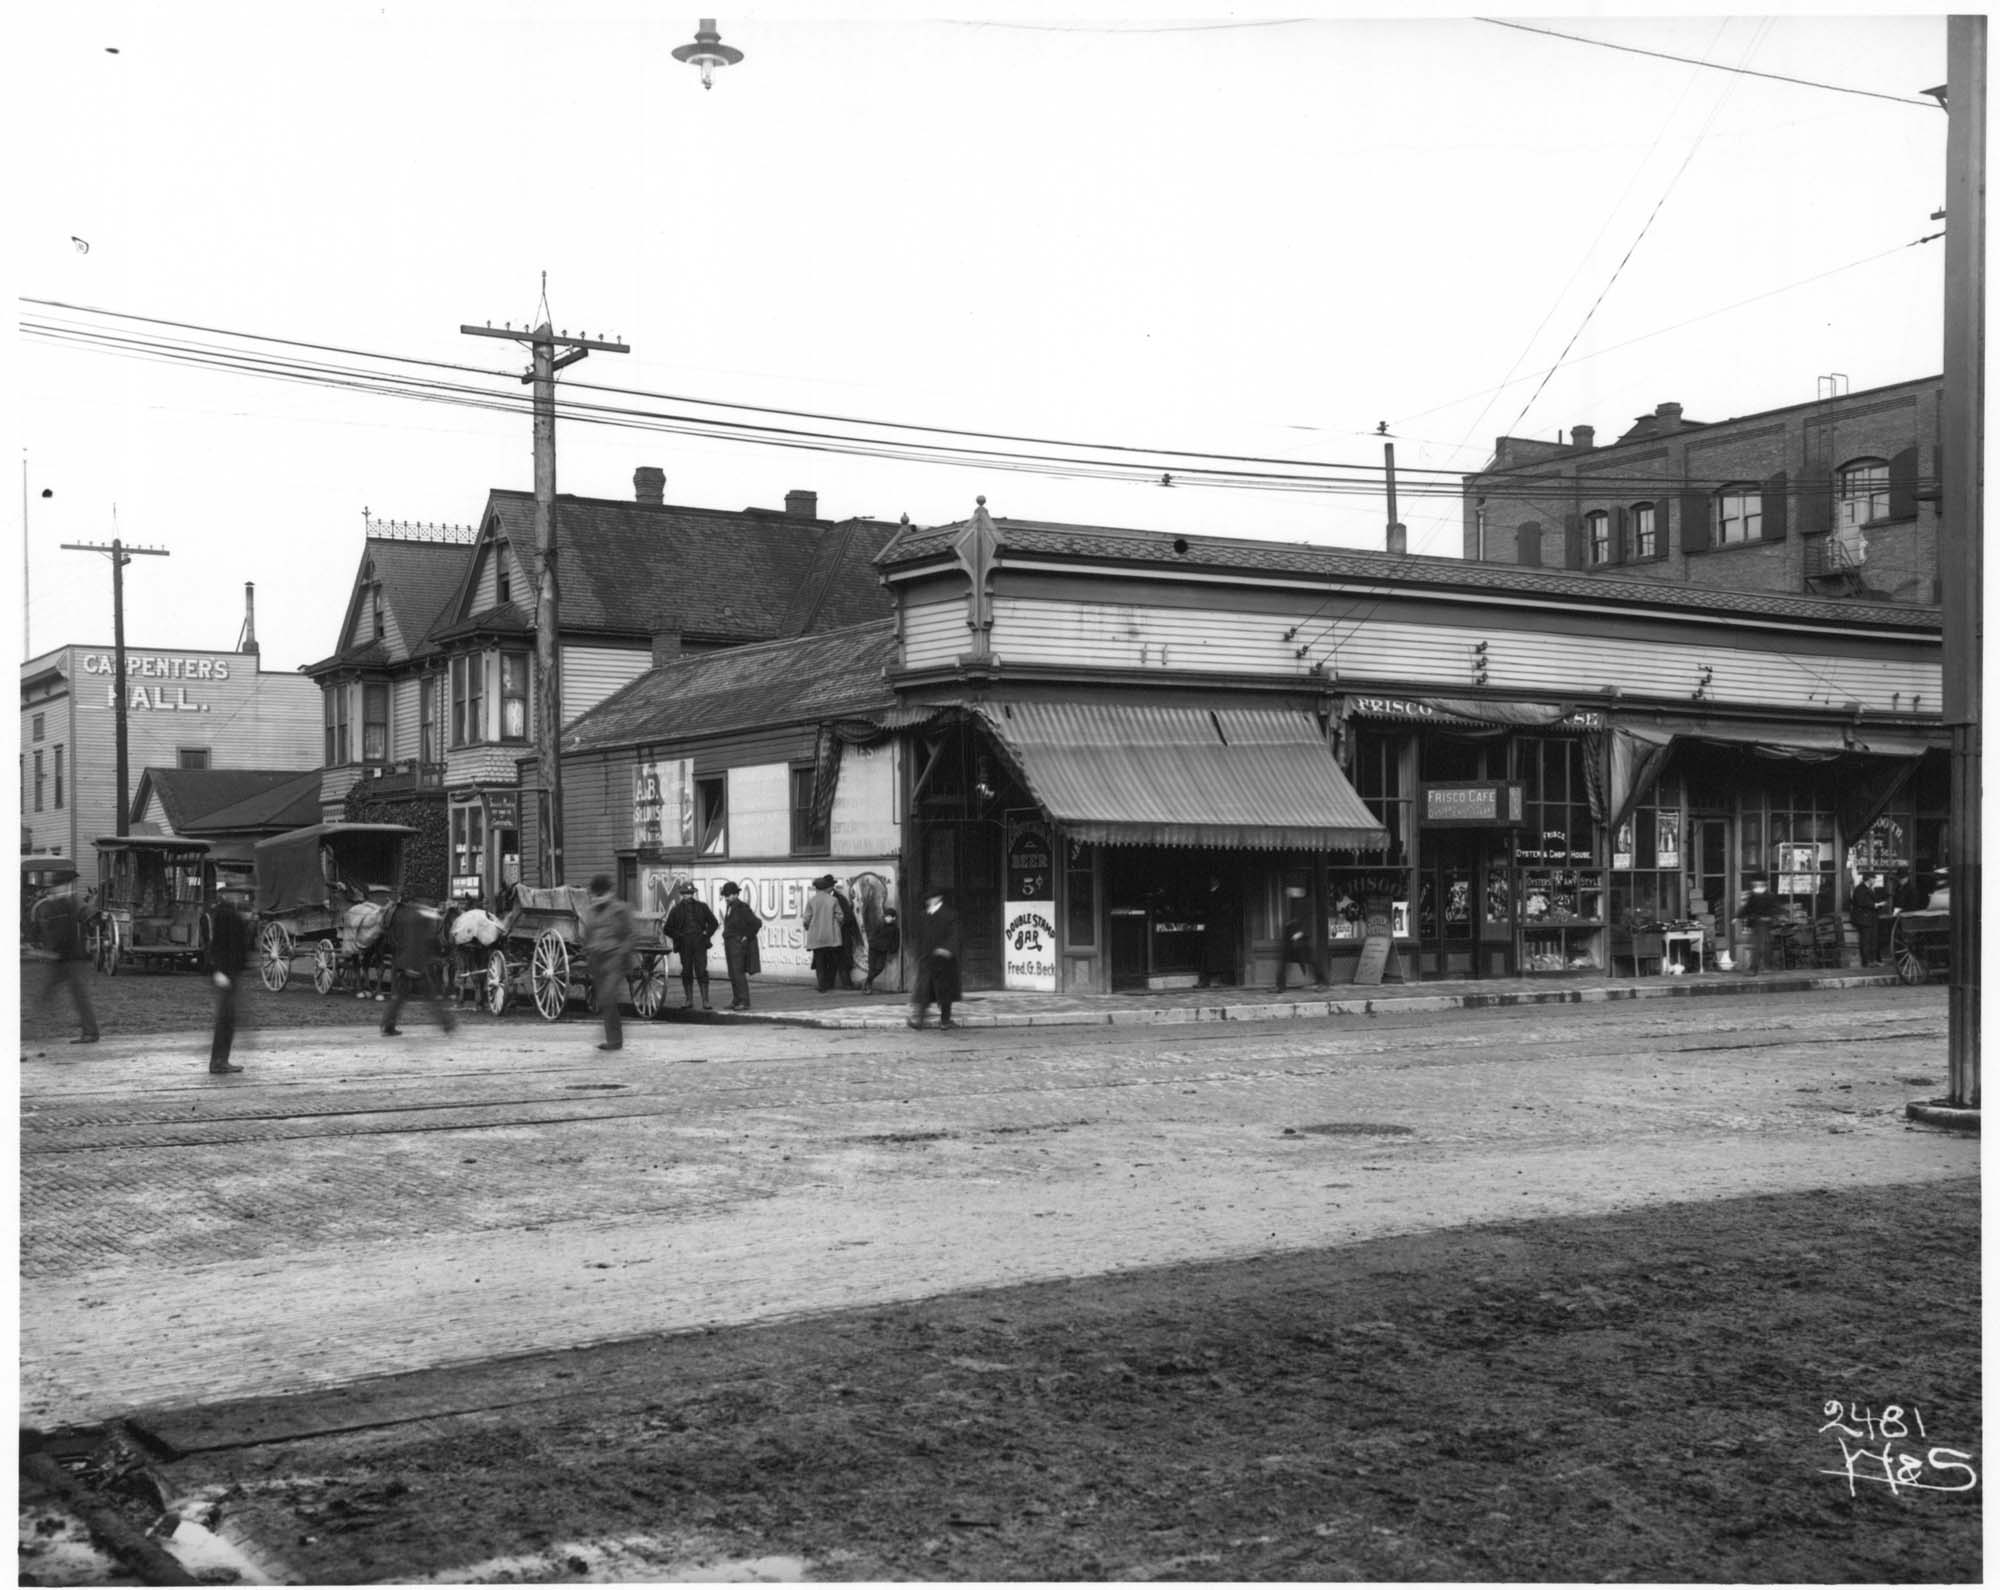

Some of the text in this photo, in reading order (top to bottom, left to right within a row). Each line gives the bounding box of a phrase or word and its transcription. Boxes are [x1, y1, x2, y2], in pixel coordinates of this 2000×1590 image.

[1428, 790, 1497, 803] FRISCO CAFE
[1005, 912, 1056, 941] DOUBLE STAMP
[1014, 930, 1043, 952] BAR
